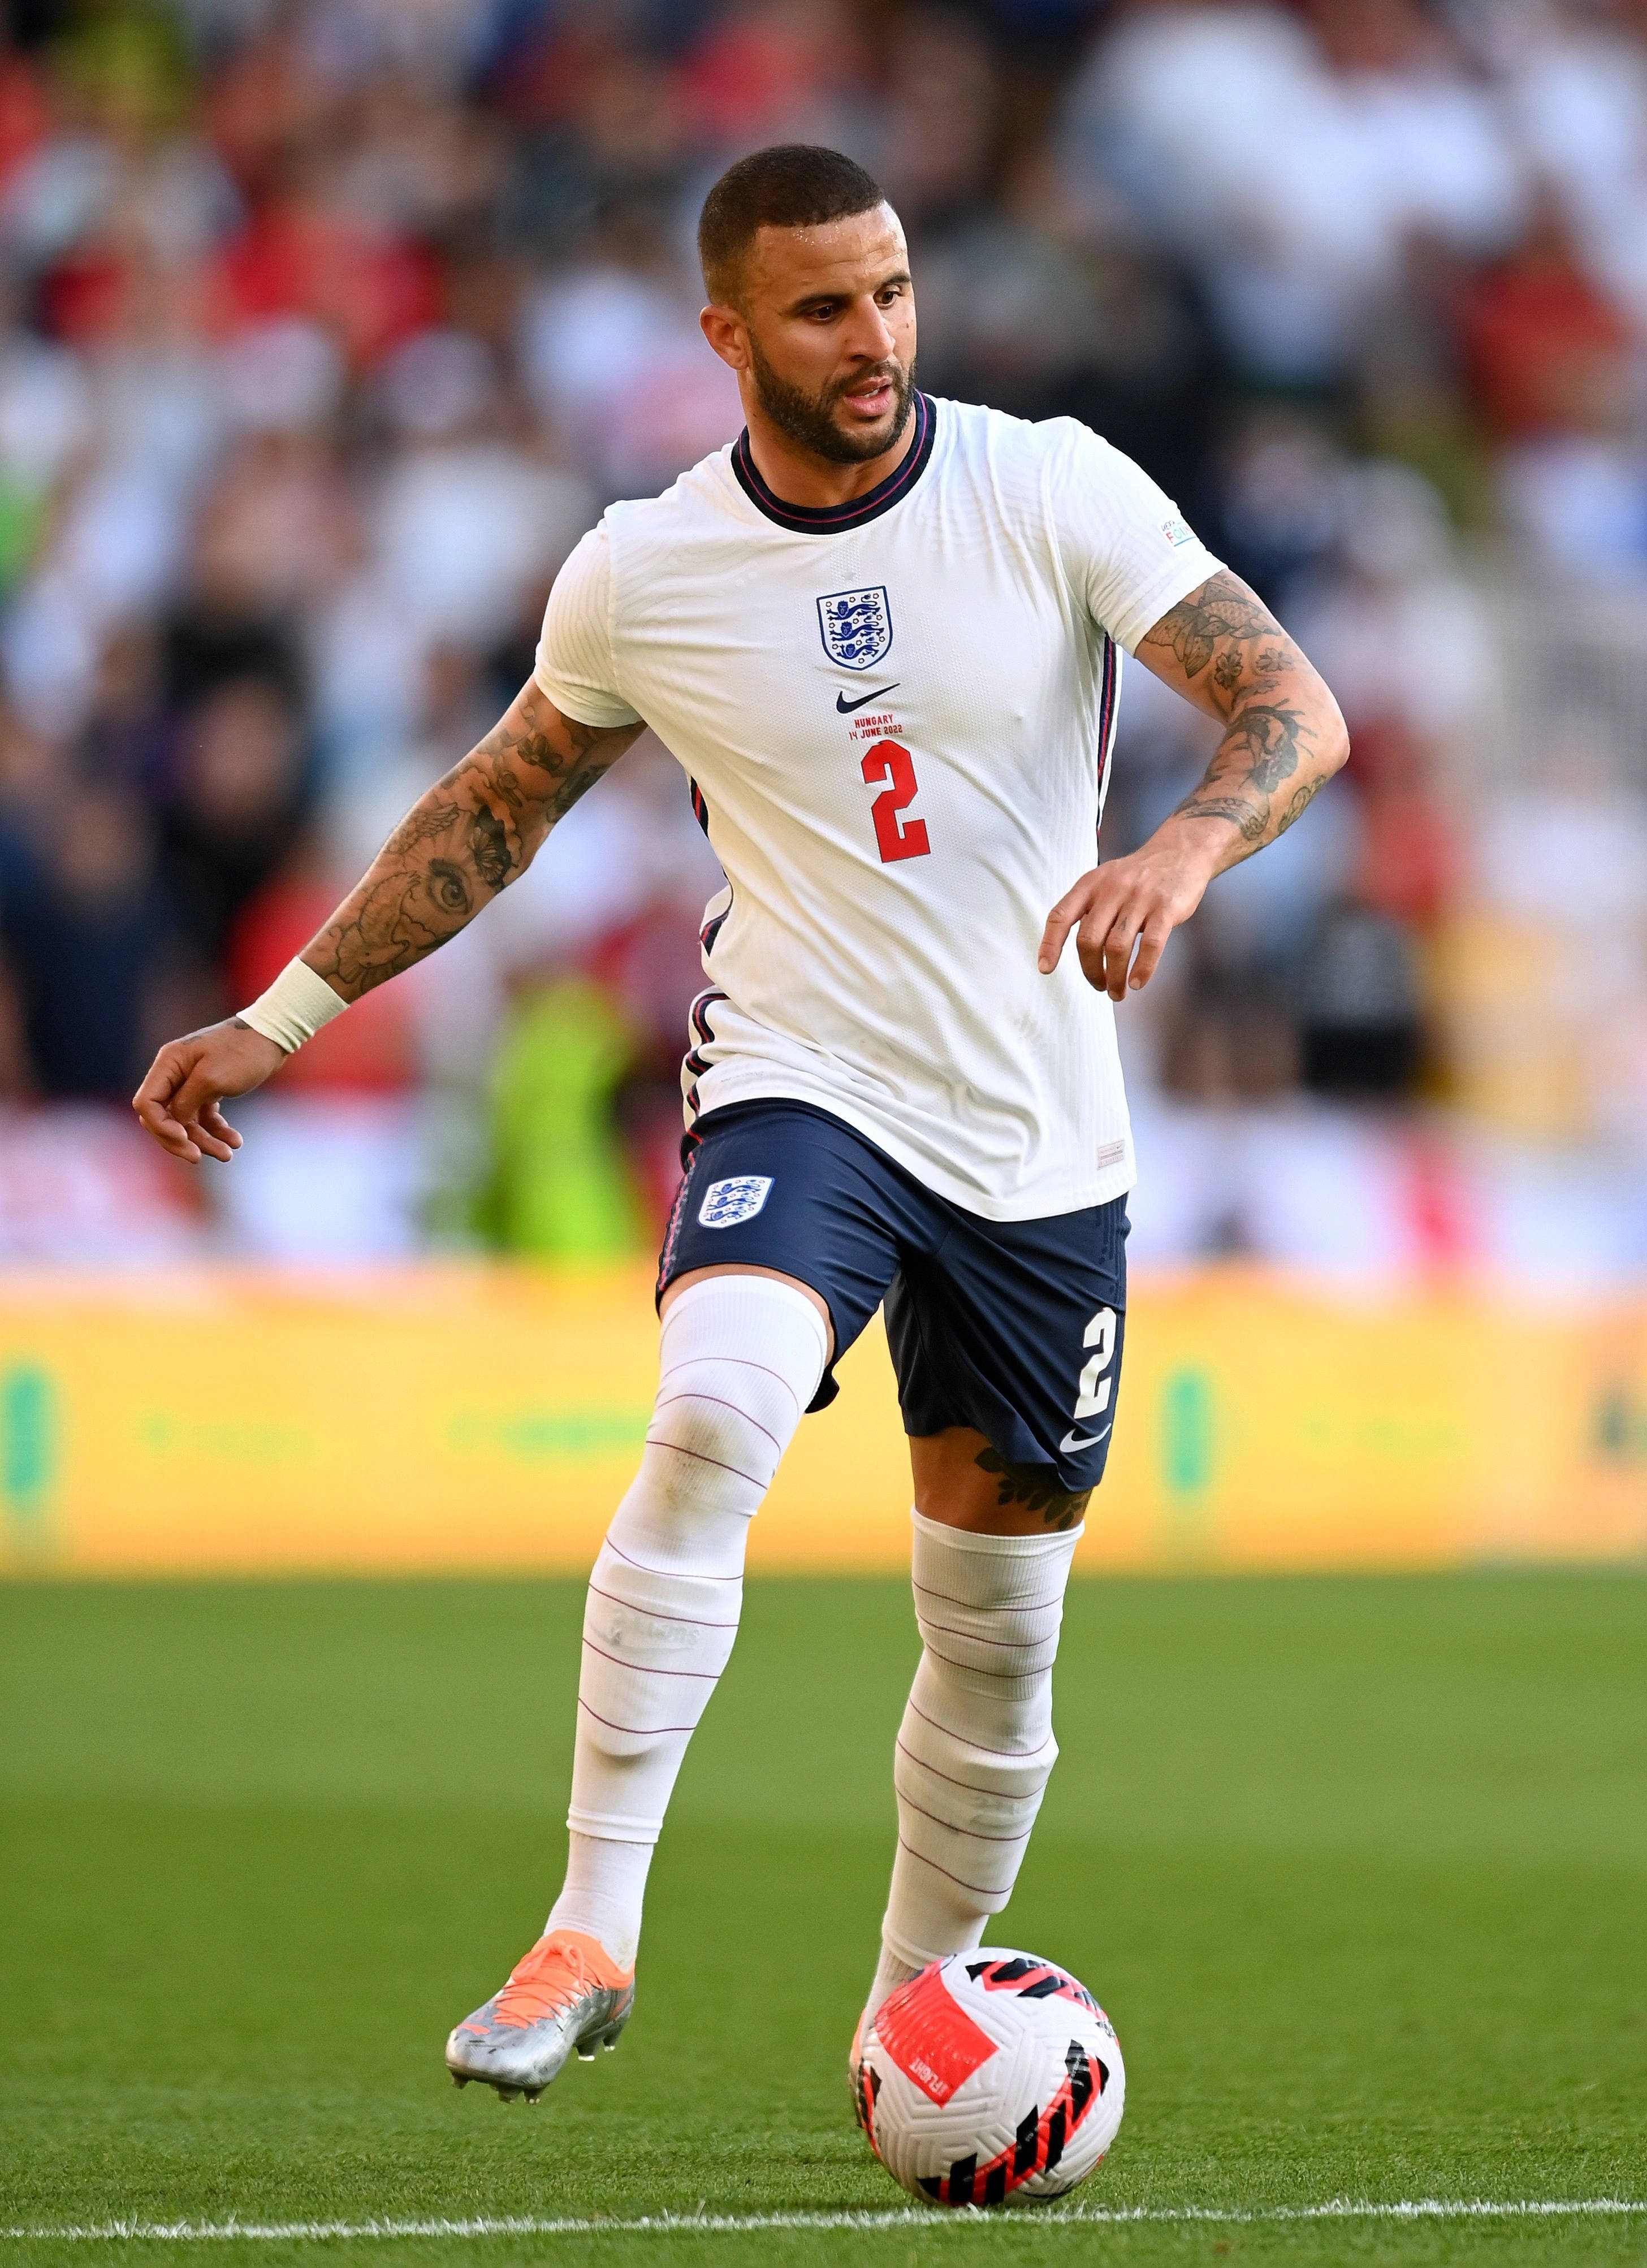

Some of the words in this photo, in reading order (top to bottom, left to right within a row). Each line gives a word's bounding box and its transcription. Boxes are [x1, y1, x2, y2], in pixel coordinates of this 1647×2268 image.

[849, 731, 858, 741] 14
[861, 727, 881, 739] JUNE
[884, 724, 903, 734] 2022
[854, 714, 893, 728] HUNGARY
[861, 739, 931, 863] 2
[1074, 1307, 1116, 1419] 2
